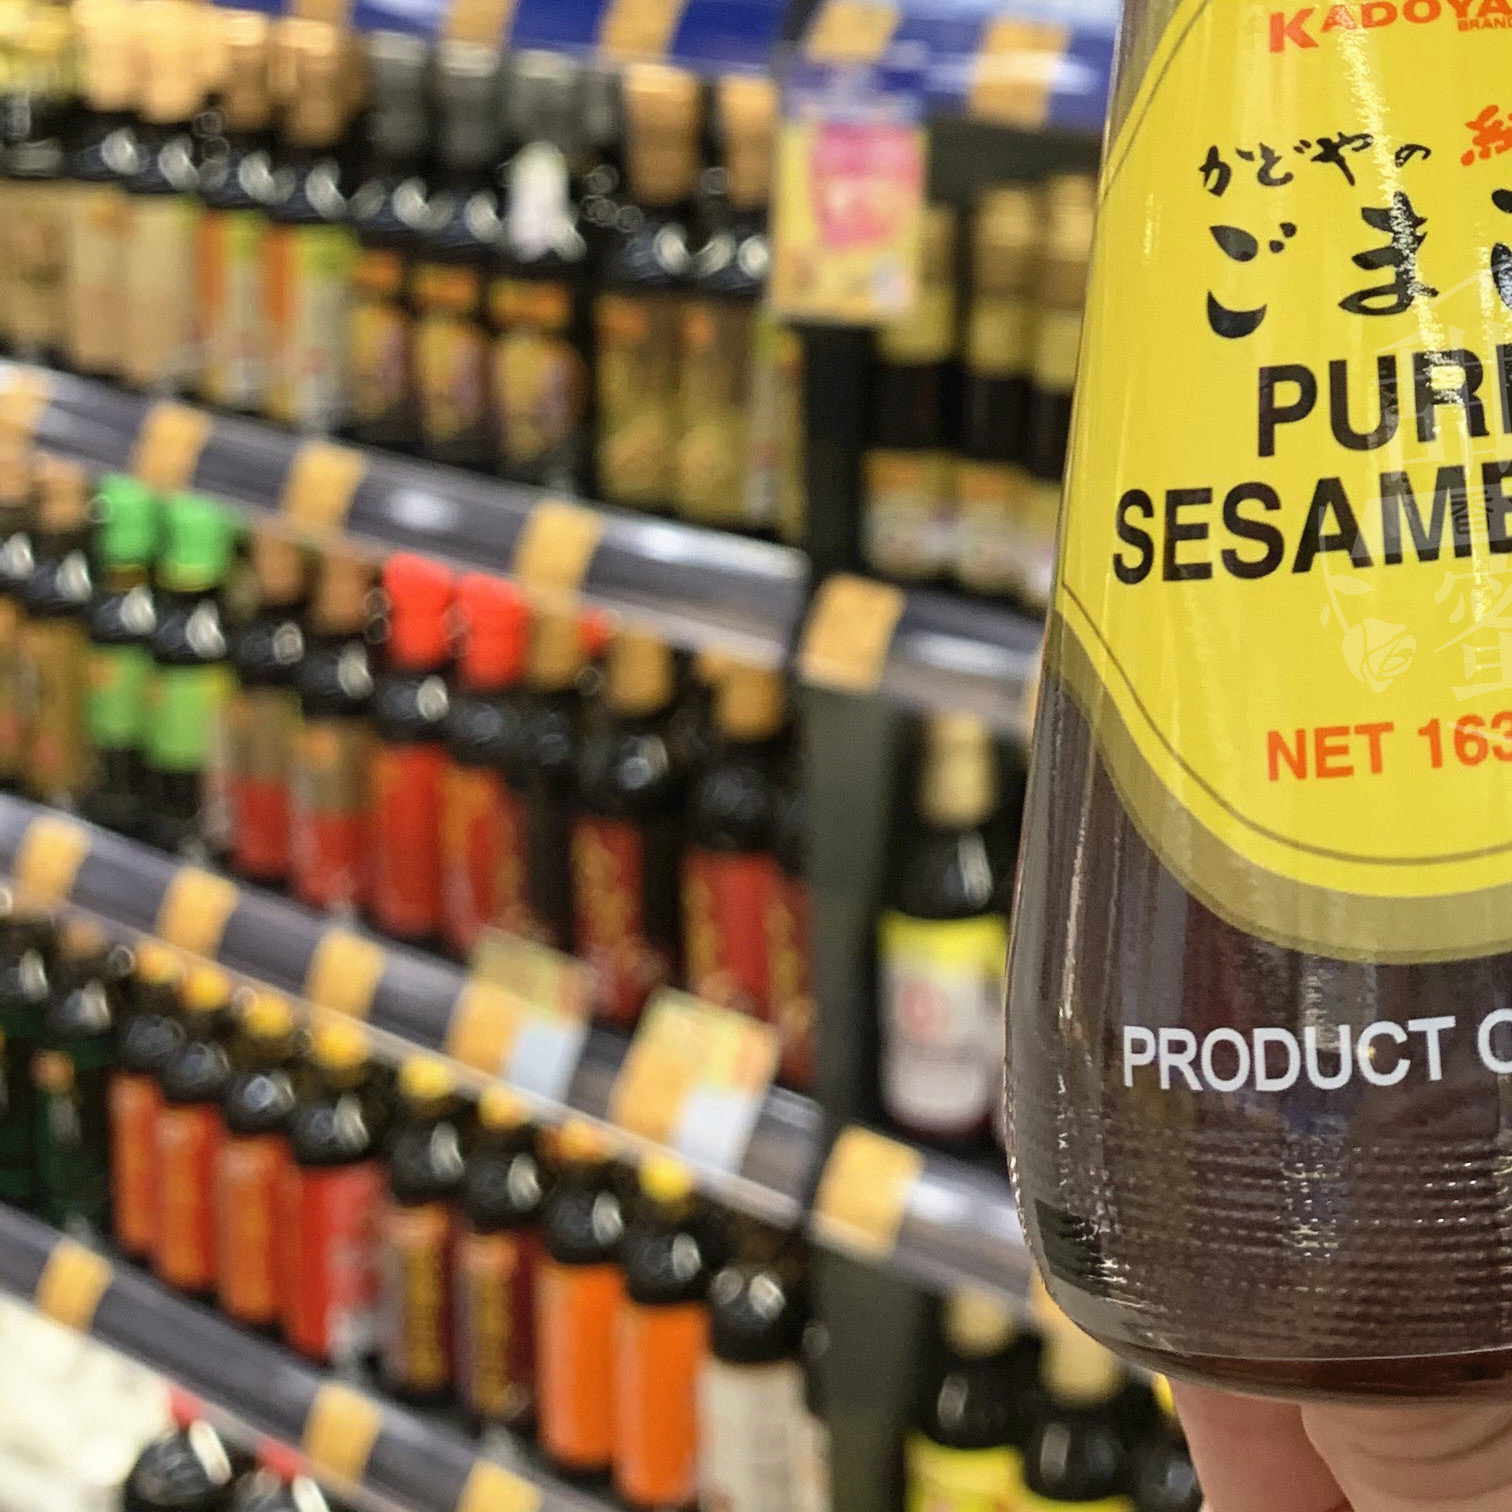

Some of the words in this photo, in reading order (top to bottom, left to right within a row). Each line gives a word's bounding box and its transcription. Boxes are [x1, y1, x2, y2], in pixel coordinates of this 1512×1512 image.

[1199, 131, 1431, 197] かどやの
[1267, 721, 1394, 782] NET
[1123, 1016, 1456, 1092] PRODUCT
